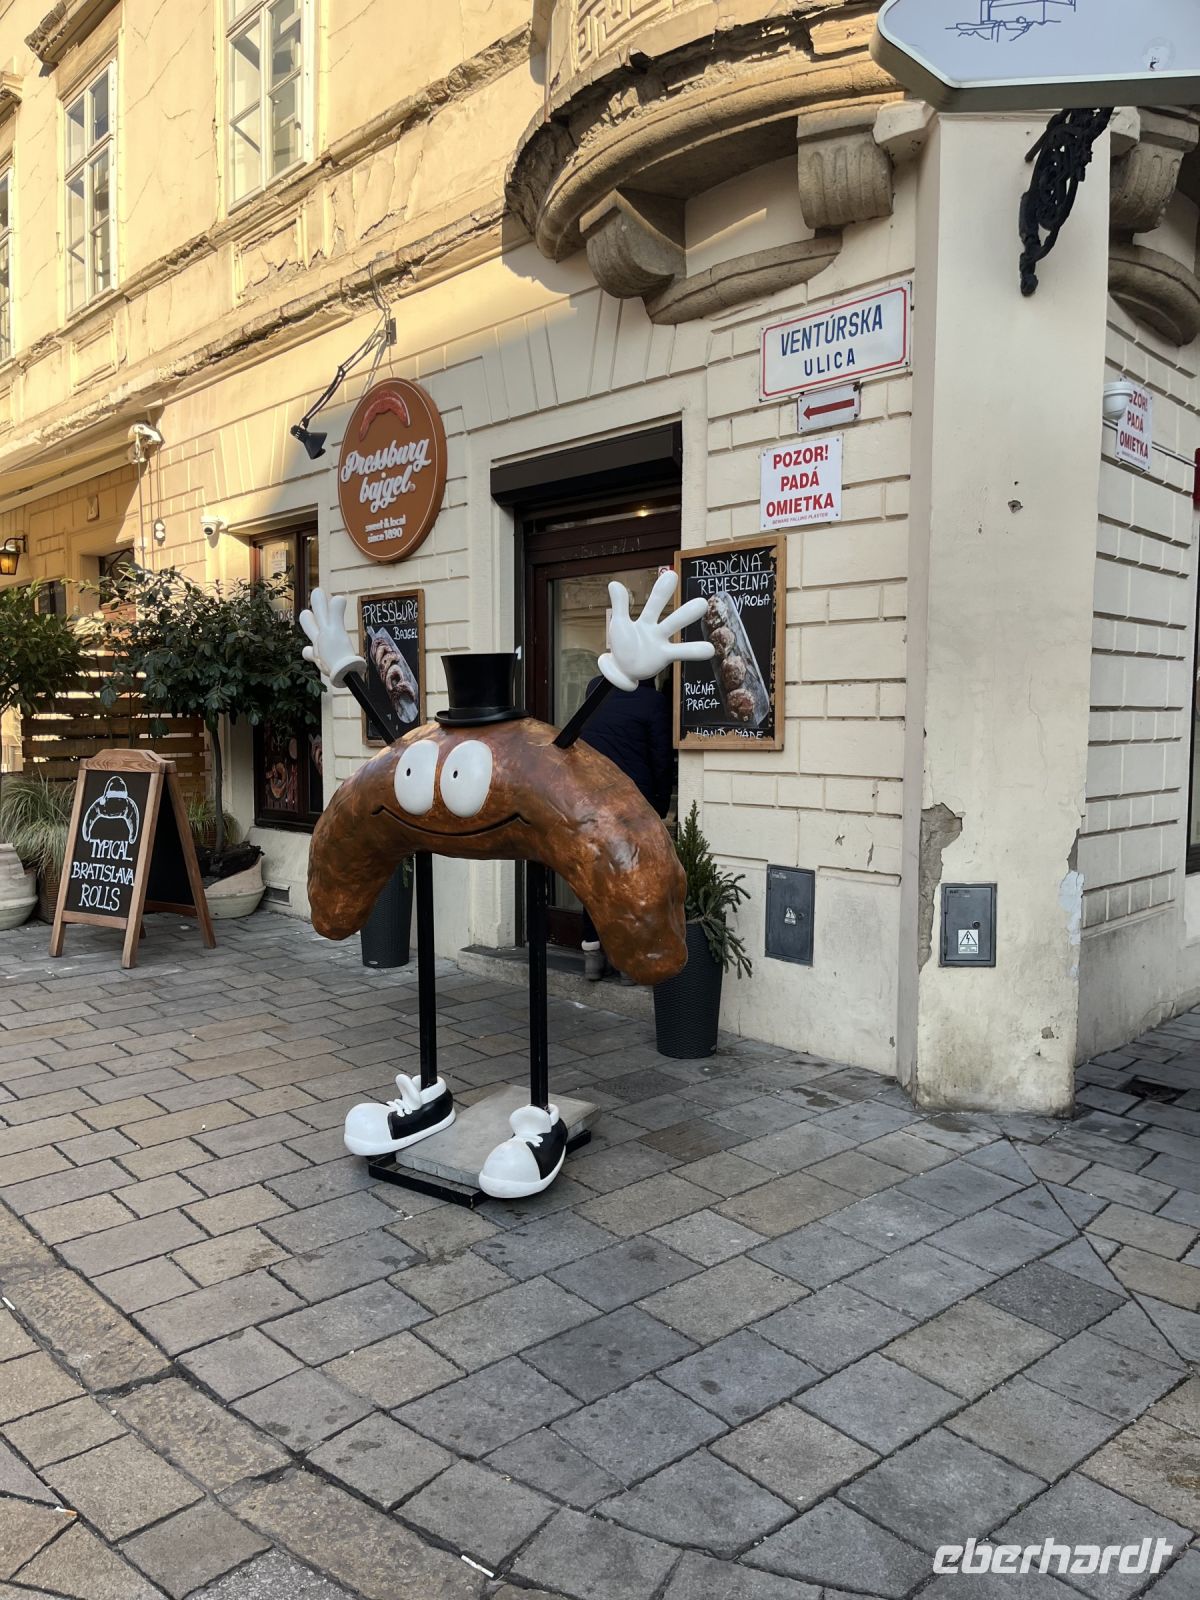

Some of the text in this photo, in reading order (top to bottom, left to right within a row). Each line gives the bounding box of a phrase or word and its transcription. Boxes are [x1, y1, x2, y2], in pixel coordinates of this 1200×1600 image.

[781, 304, 883, 357] VENTÚRSKA
[804, 348, 856, 377] ULICA
[1127, 410, 1144, 433] PADÁ
[773, 444, 829, 470] POZOR!
[1120, 430, 1148, 459] OMIETKA
[341, 439, 432, 482] Pressburg
[360, 465, 413, 513] bajgel
[780, 466, 820, 492] PADÁ
[766, 492, 834, 517] OMIETKA
[390, 514, 406, 526] local
[384, 527, 403, 540] 1890
[691, 551, 766, 577] TRADIČNÁ
[698, 573, 774, 595] REMESELNÁ
[684, 680, 716, 696] RUČNÁ
[686, 697, 720, 711] PRÁCA
[89, 838, 133, 861] TYPICAL
[71, 861, 135, 887] BRATISLAVA
[78, 882, 121, 912] ROLLS
